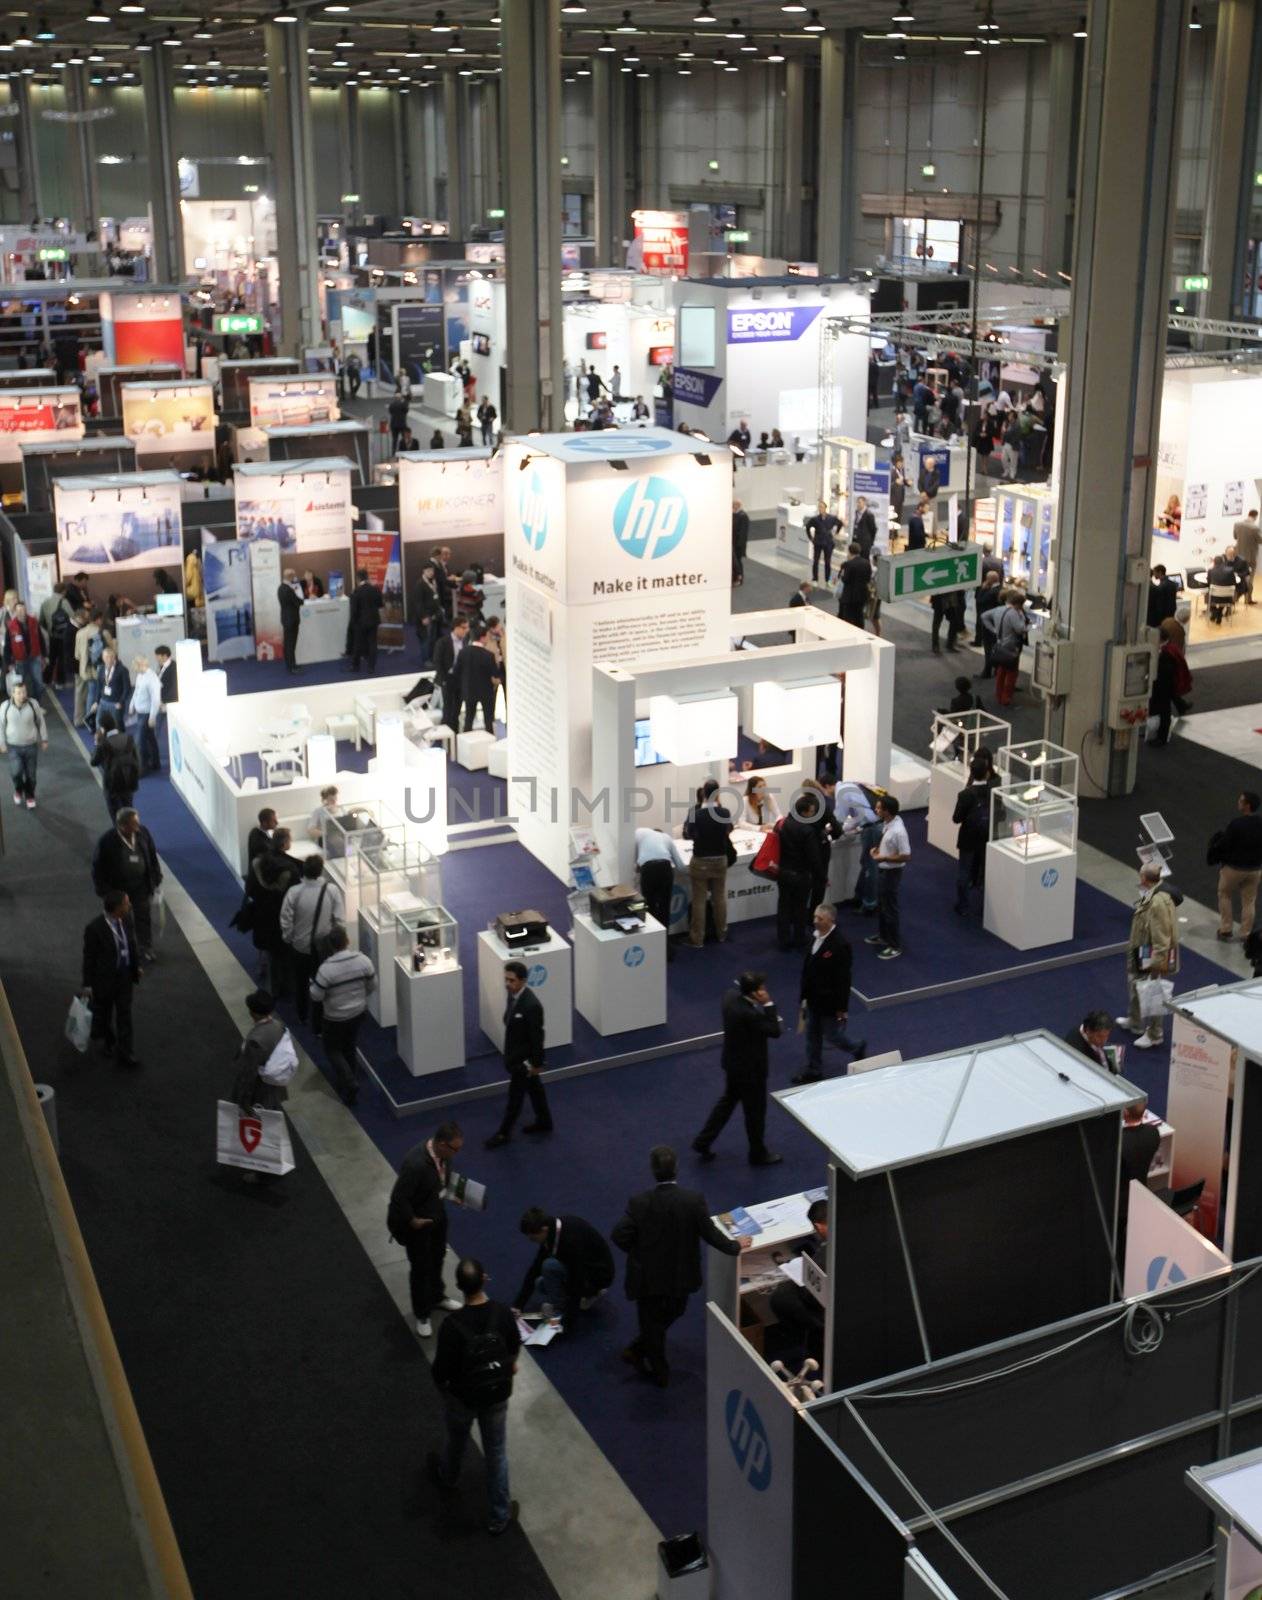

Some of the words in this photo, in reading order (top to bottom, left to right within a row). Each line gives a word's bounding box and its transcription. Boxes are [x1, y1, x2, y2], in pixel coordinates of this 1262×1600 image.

[731, 312, 792, 332] EPSON
[674, 372, 705, 394] EPSON
[614, 475, 688, 560] hp
[593, 578, 633, 595] Make
[636, 576, 648, 590] it
[652, 573, 708, 589] matter.
[728, 890, 735, 899] it
[737, 884, 776, 898] matter.
[623, 945, 645, 968] hp
[726, 1389, 772, 1491] hp
